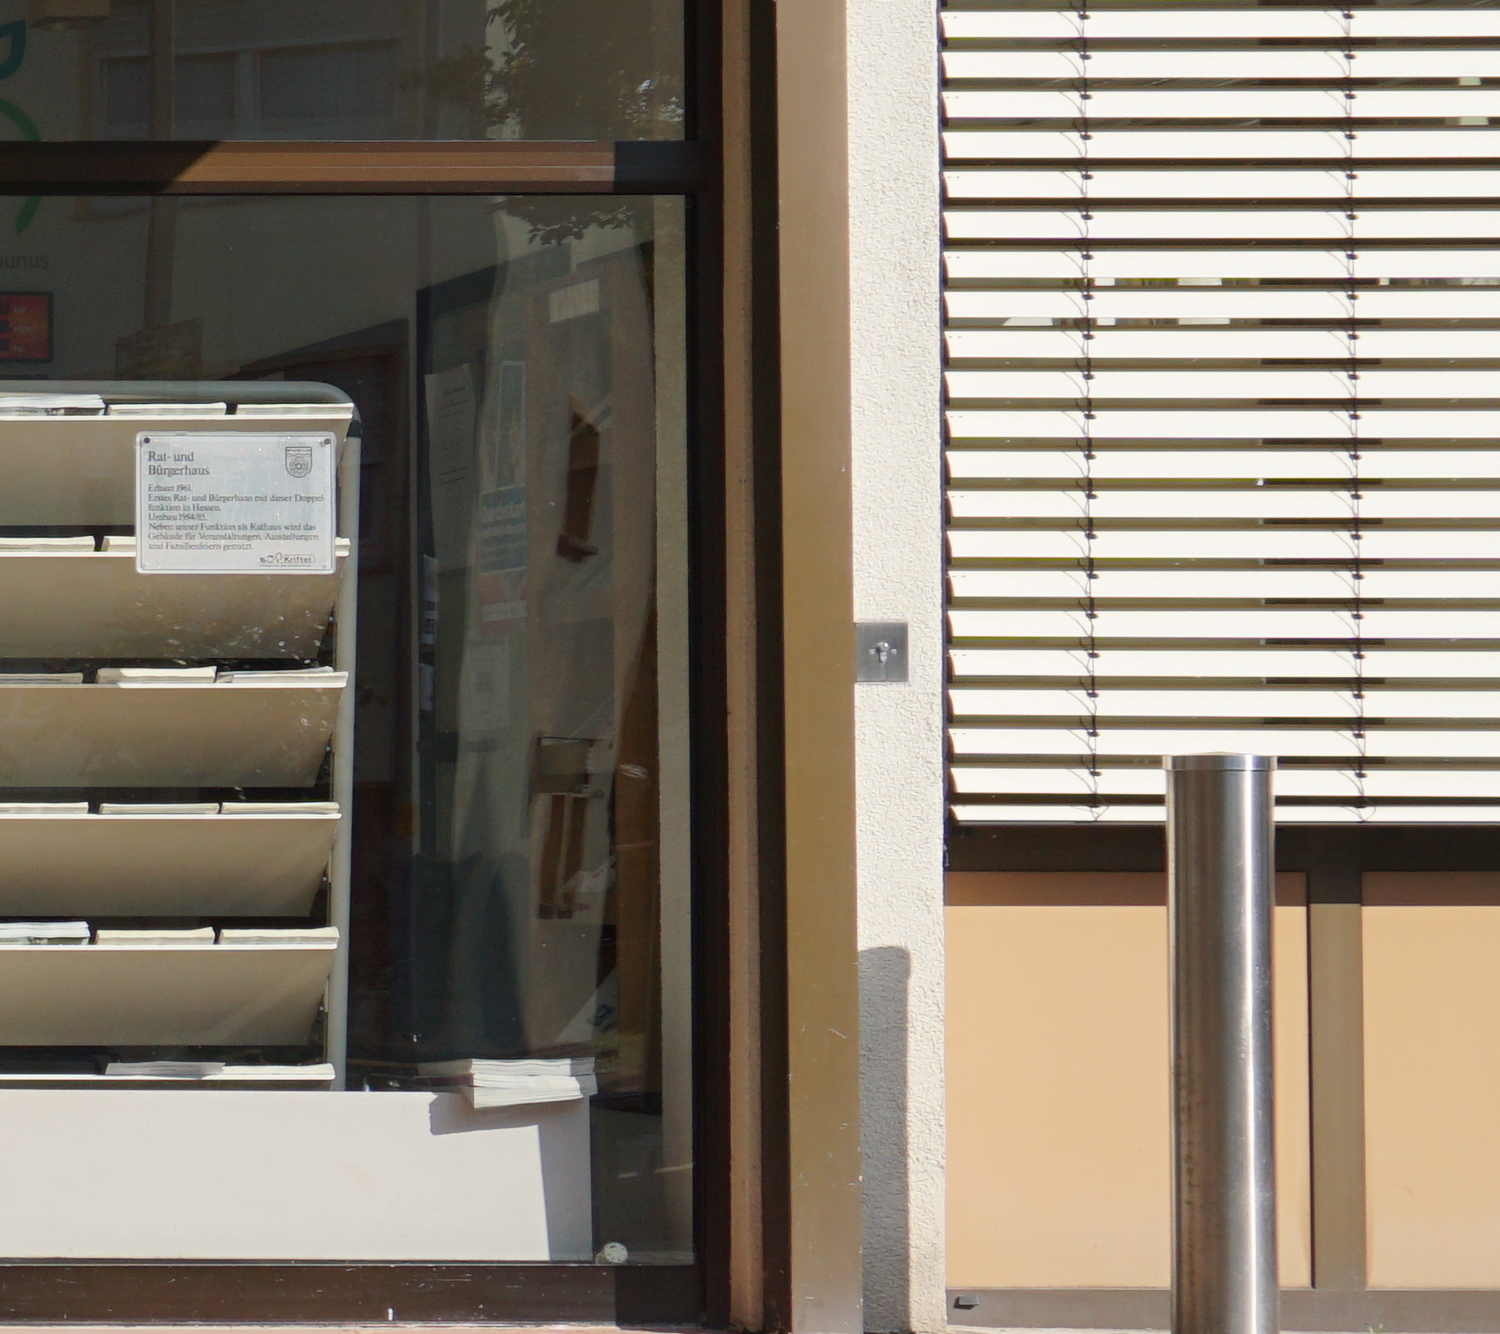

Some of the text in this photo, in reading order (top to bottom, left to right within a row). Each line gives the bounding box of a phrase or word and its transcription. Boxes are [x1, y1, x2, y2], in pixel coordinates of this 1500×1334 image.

[148, 451, 194, 462] Rat- und
[148, 465, 210, 477] Bürgerhaus
